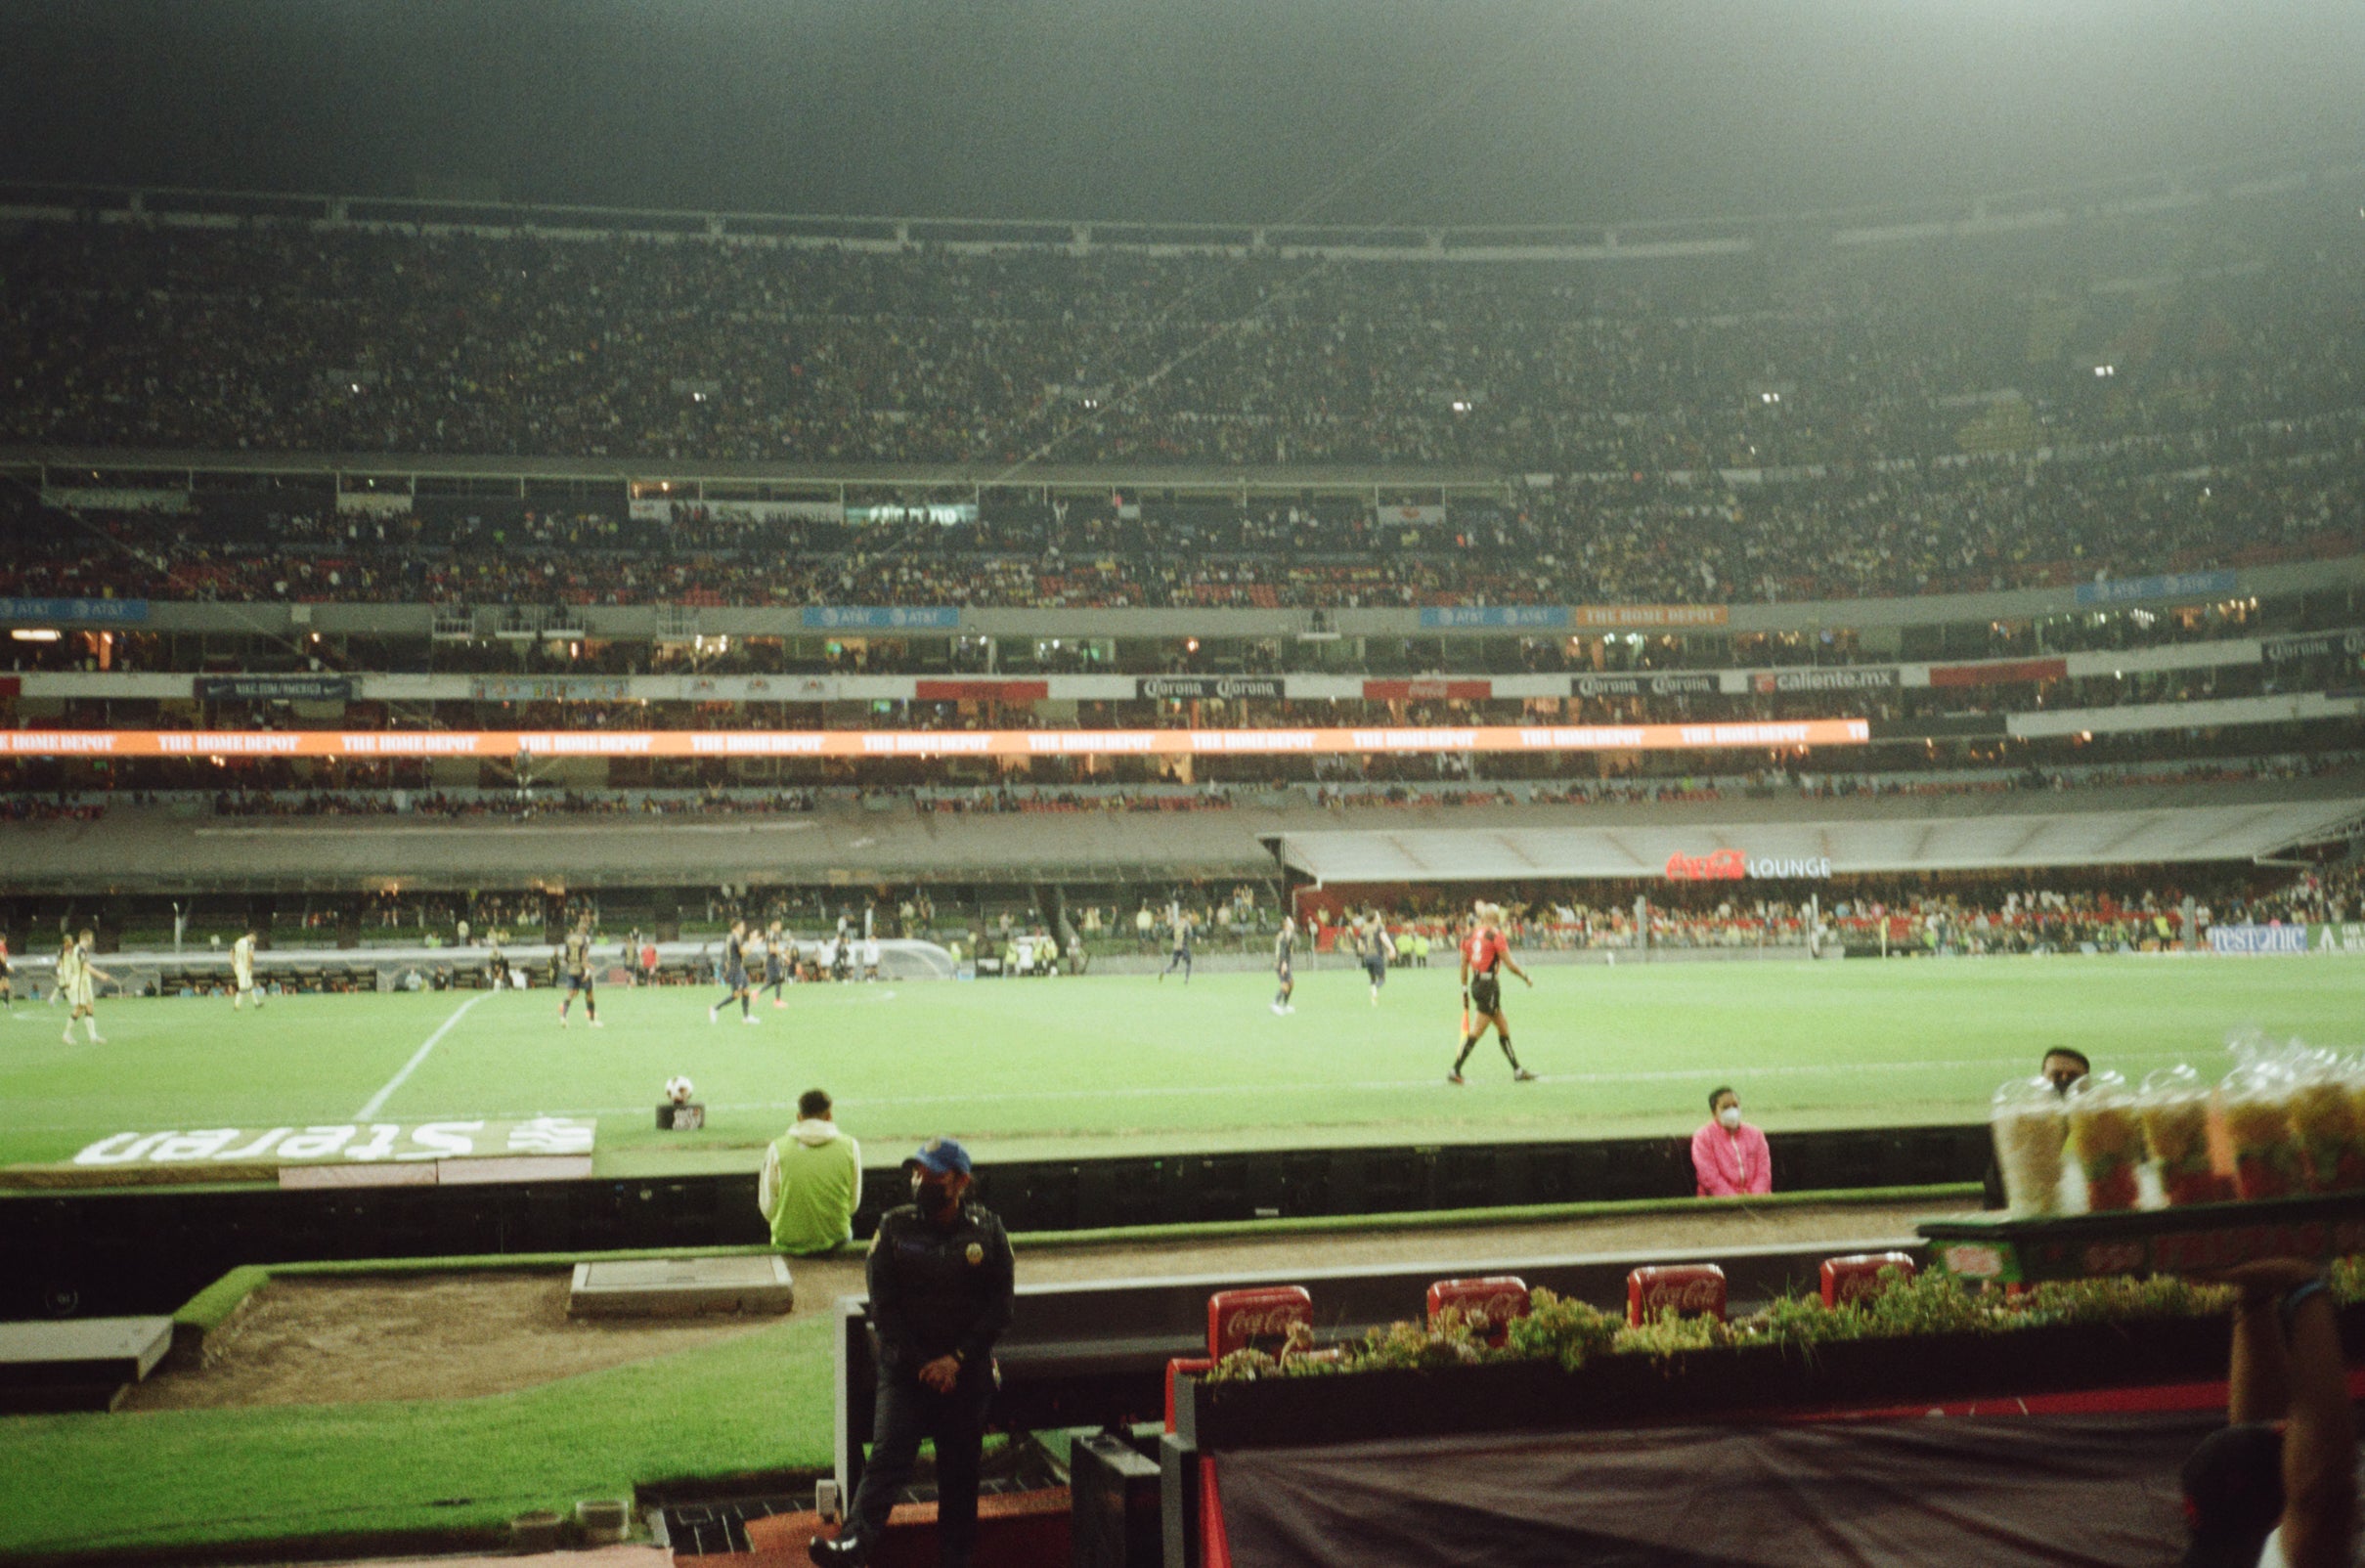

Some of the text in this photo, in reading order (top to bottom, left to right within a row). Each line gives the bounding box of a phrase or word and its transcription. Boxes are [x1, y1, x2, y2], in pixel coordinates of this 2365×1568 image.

[1586, 608, 1718, 624] THE HOME DEPOT
[1144, 678, 1204, 698] Corona
[1216, 678, 1277, 699] Corona
[1579, 676, 1639, 697] Corona
[1651, 675, 1712, 696] Corona
[61, 733, 116, 751] DEPOT
[158, 734, 193, 752] THE
[342, 735, 375, 752] THE
[518, 735, 550, 752] THE
[690, 735, 723, 752] THE
[862, 735, 894, 752] THE
[1028, 734, 1059, 751] THE
[1191, 732, 1222, 749] THE
[1352, 731, 1383, 748] THE
[1519, 729, 1552, 747] THE
[1680, 727, 1713, 744] THE
[1749, 857, 1831, 879] LOUNGE
[74, 1120, 485, 1164] Steren
